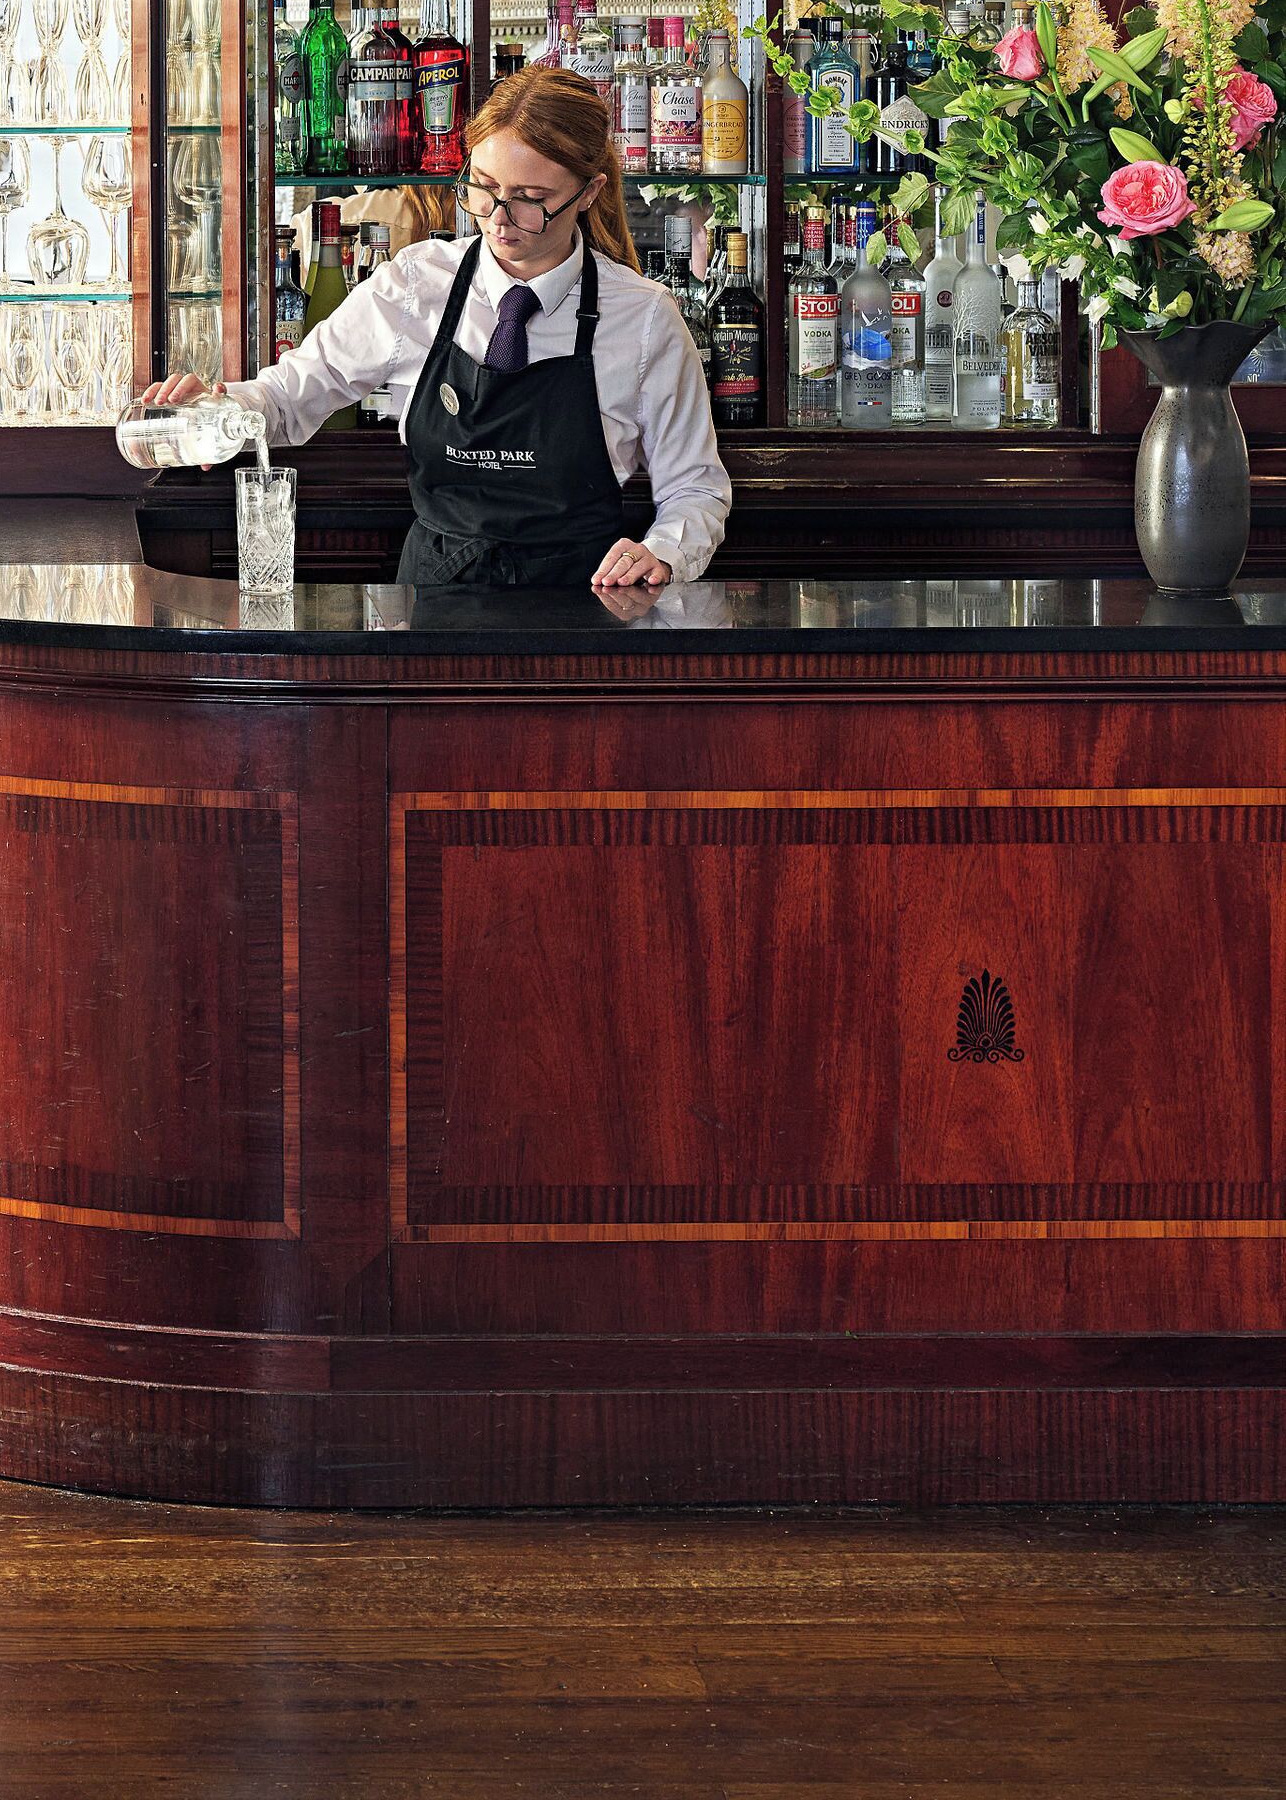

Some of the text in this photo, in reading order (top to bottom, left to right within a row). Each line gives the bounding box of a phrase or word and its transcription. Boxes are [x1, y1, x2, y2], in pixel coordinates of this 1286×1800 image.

[418, 66, 459, 87] APEROL
[825, 76, 847, 87] BOMBAY
[662, 91, 694, 105] Chase
[671, 108, 687, 116] GIN
[800, 300, 836, 314] STOLI
[804, 330, 832, 338] VODKA
[845, 371, 862, 380] GREY
[446, 444, 535, 462] BUXTED PARK
[477, 461, 503, 470] HOTEL
